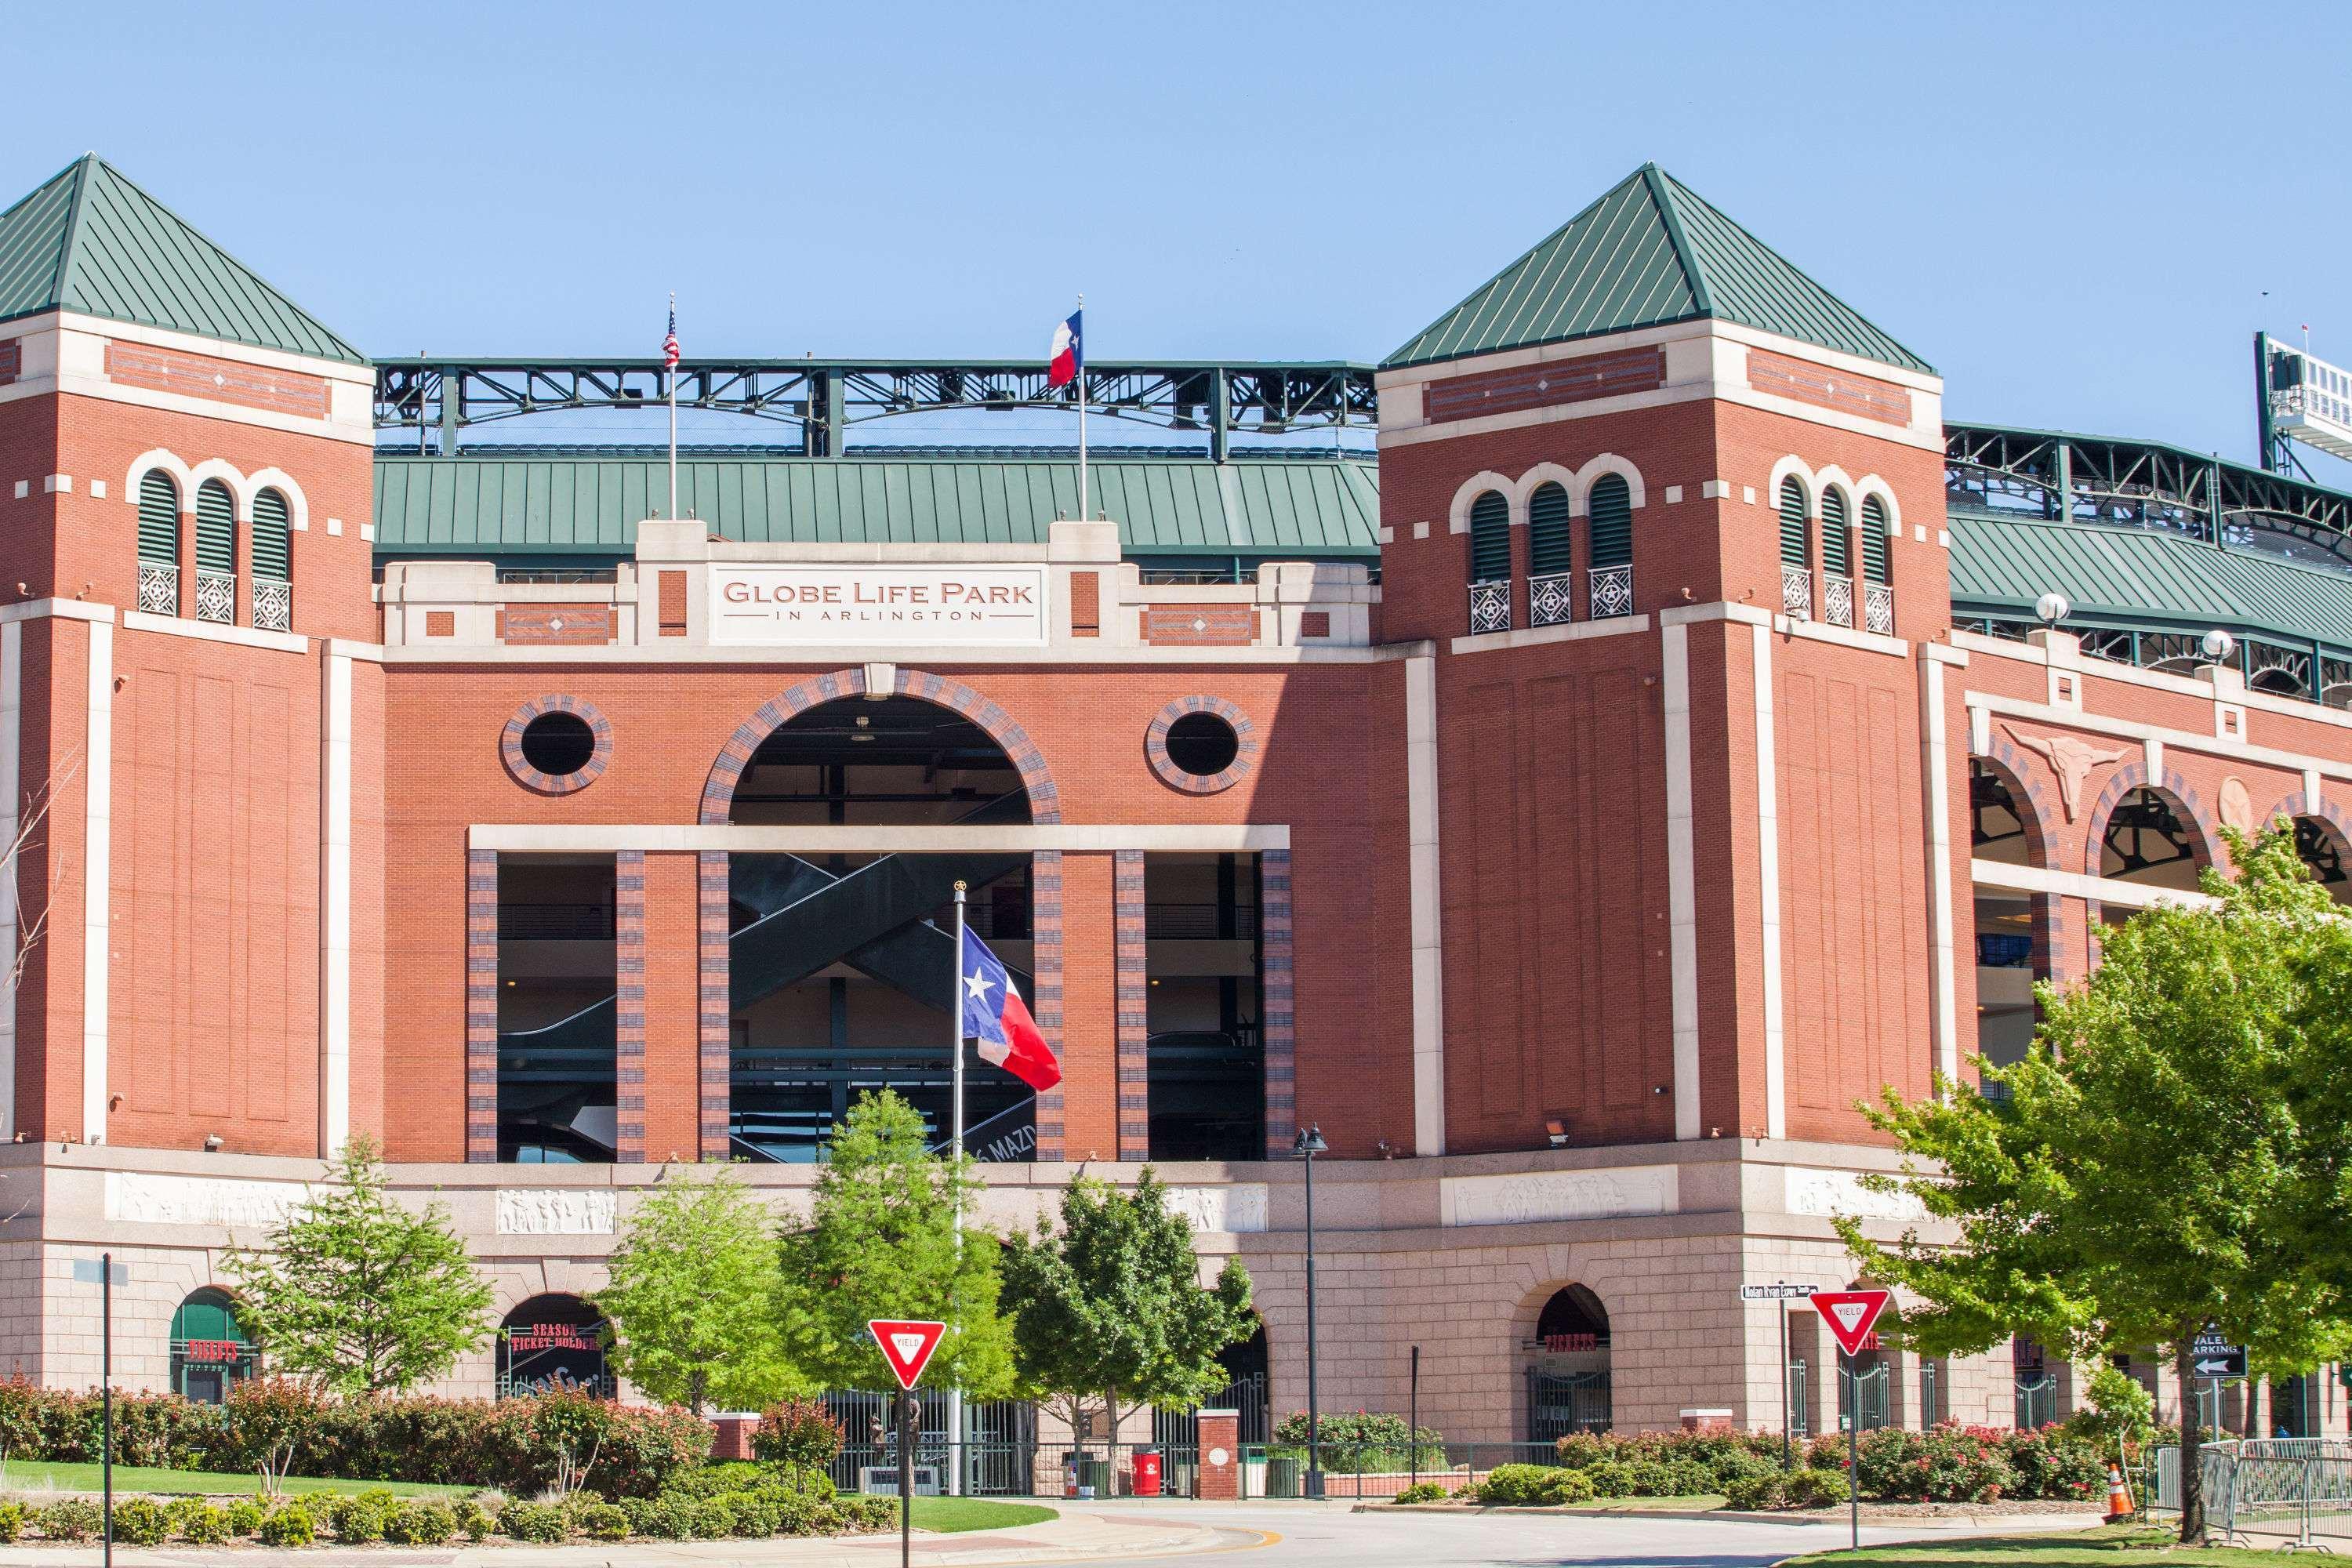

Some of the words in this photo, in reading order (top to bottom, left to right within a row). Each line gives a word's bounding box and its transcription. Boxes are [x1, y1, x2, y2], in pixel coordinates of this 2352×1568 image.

[723, 582, 842, 604] GLOBE
[853, 583, 929, 604] LIFE
[940, 583, 1033, 604] PARK
[775, 612, 801, 622] IN
[820, 611, 982, 622] ARLINGTON
[988, 1124, 1036, 1163] MAZD
[1744, 1286, 1763, 1298] Nolan
[1763, 1286, 1780, 1298] Ryan
[1838, 1307, 1862, 1316] YIELD
[532, 1323, 577, 1337] SEASON
[511, 1337, 551, 1352] TICKET
[897, 1338, 919, 1347] YIELD
[1544, 1333, 1596, 1354] TICKETS
[2193, 1345, 2238, 1354] ARKING
[188, 1339, 237, 1361] TICKETS
